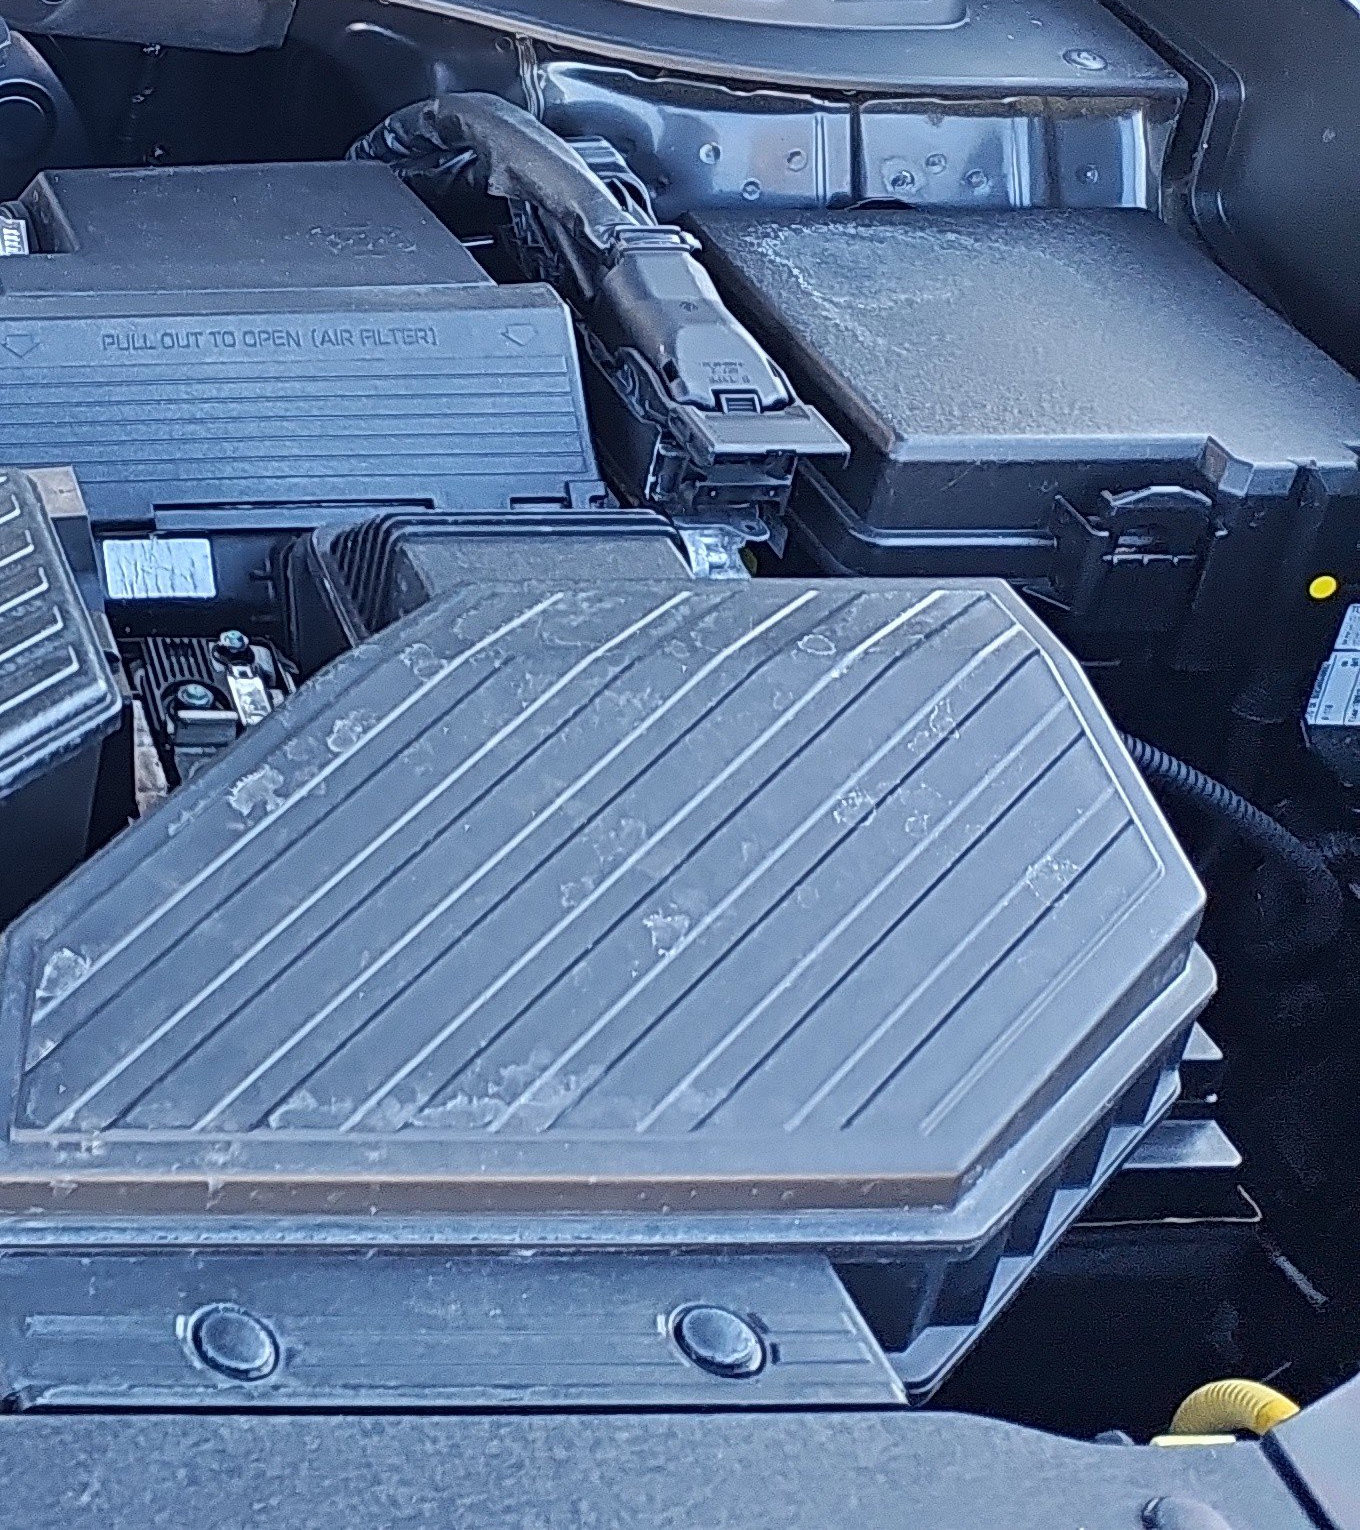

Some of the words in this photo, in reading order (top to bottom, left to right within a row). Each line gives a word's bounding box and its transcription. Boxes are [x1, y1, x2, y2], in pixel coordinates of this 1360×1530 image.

[101, 333, 157, 351] PULL
[161, 331, 203, 349] OUT
[209, 330, 237, 348] TO
[243, 329, 302, 348] OPEN
